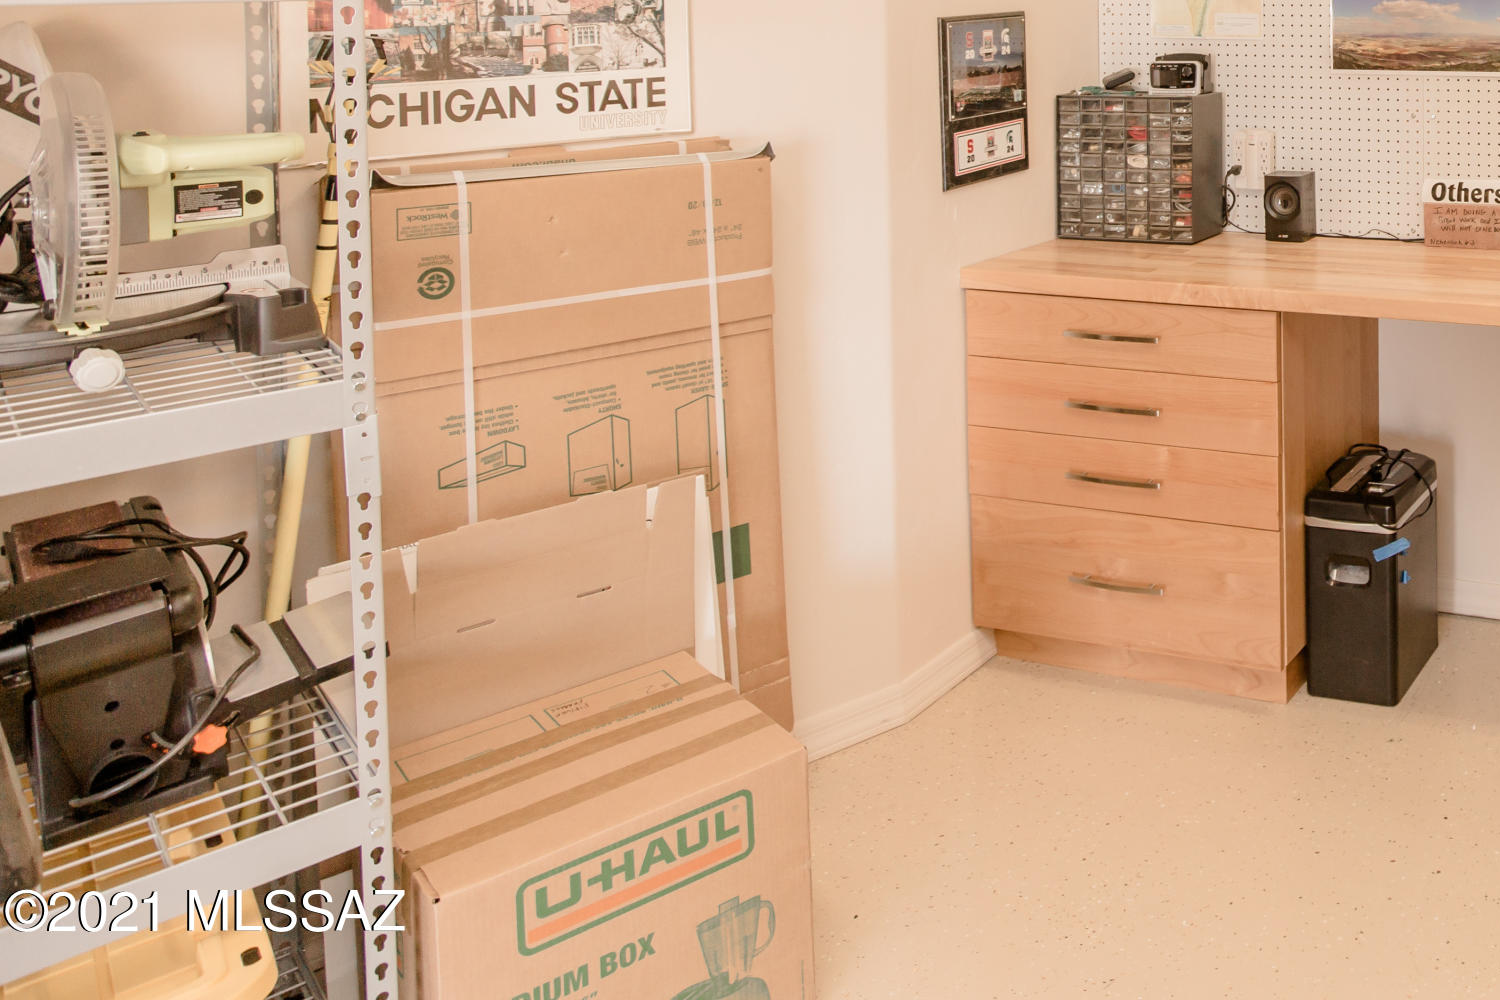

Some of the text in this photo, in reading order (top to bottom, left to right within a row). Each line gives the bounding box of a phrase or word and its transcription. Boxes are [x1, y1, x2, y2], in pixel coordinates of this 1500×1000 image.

[555, 76, 667, 116] STATE
[578, 109, 668, 132] UNIVERSITY
[967, 154, 975, 163] 20
[1006, 145, 1015, 153] 24
[406, 213, 449, 223] WestRock
[534, 808, 742, 920] U-HAUL
[599, 932, 657, 980] BOX
